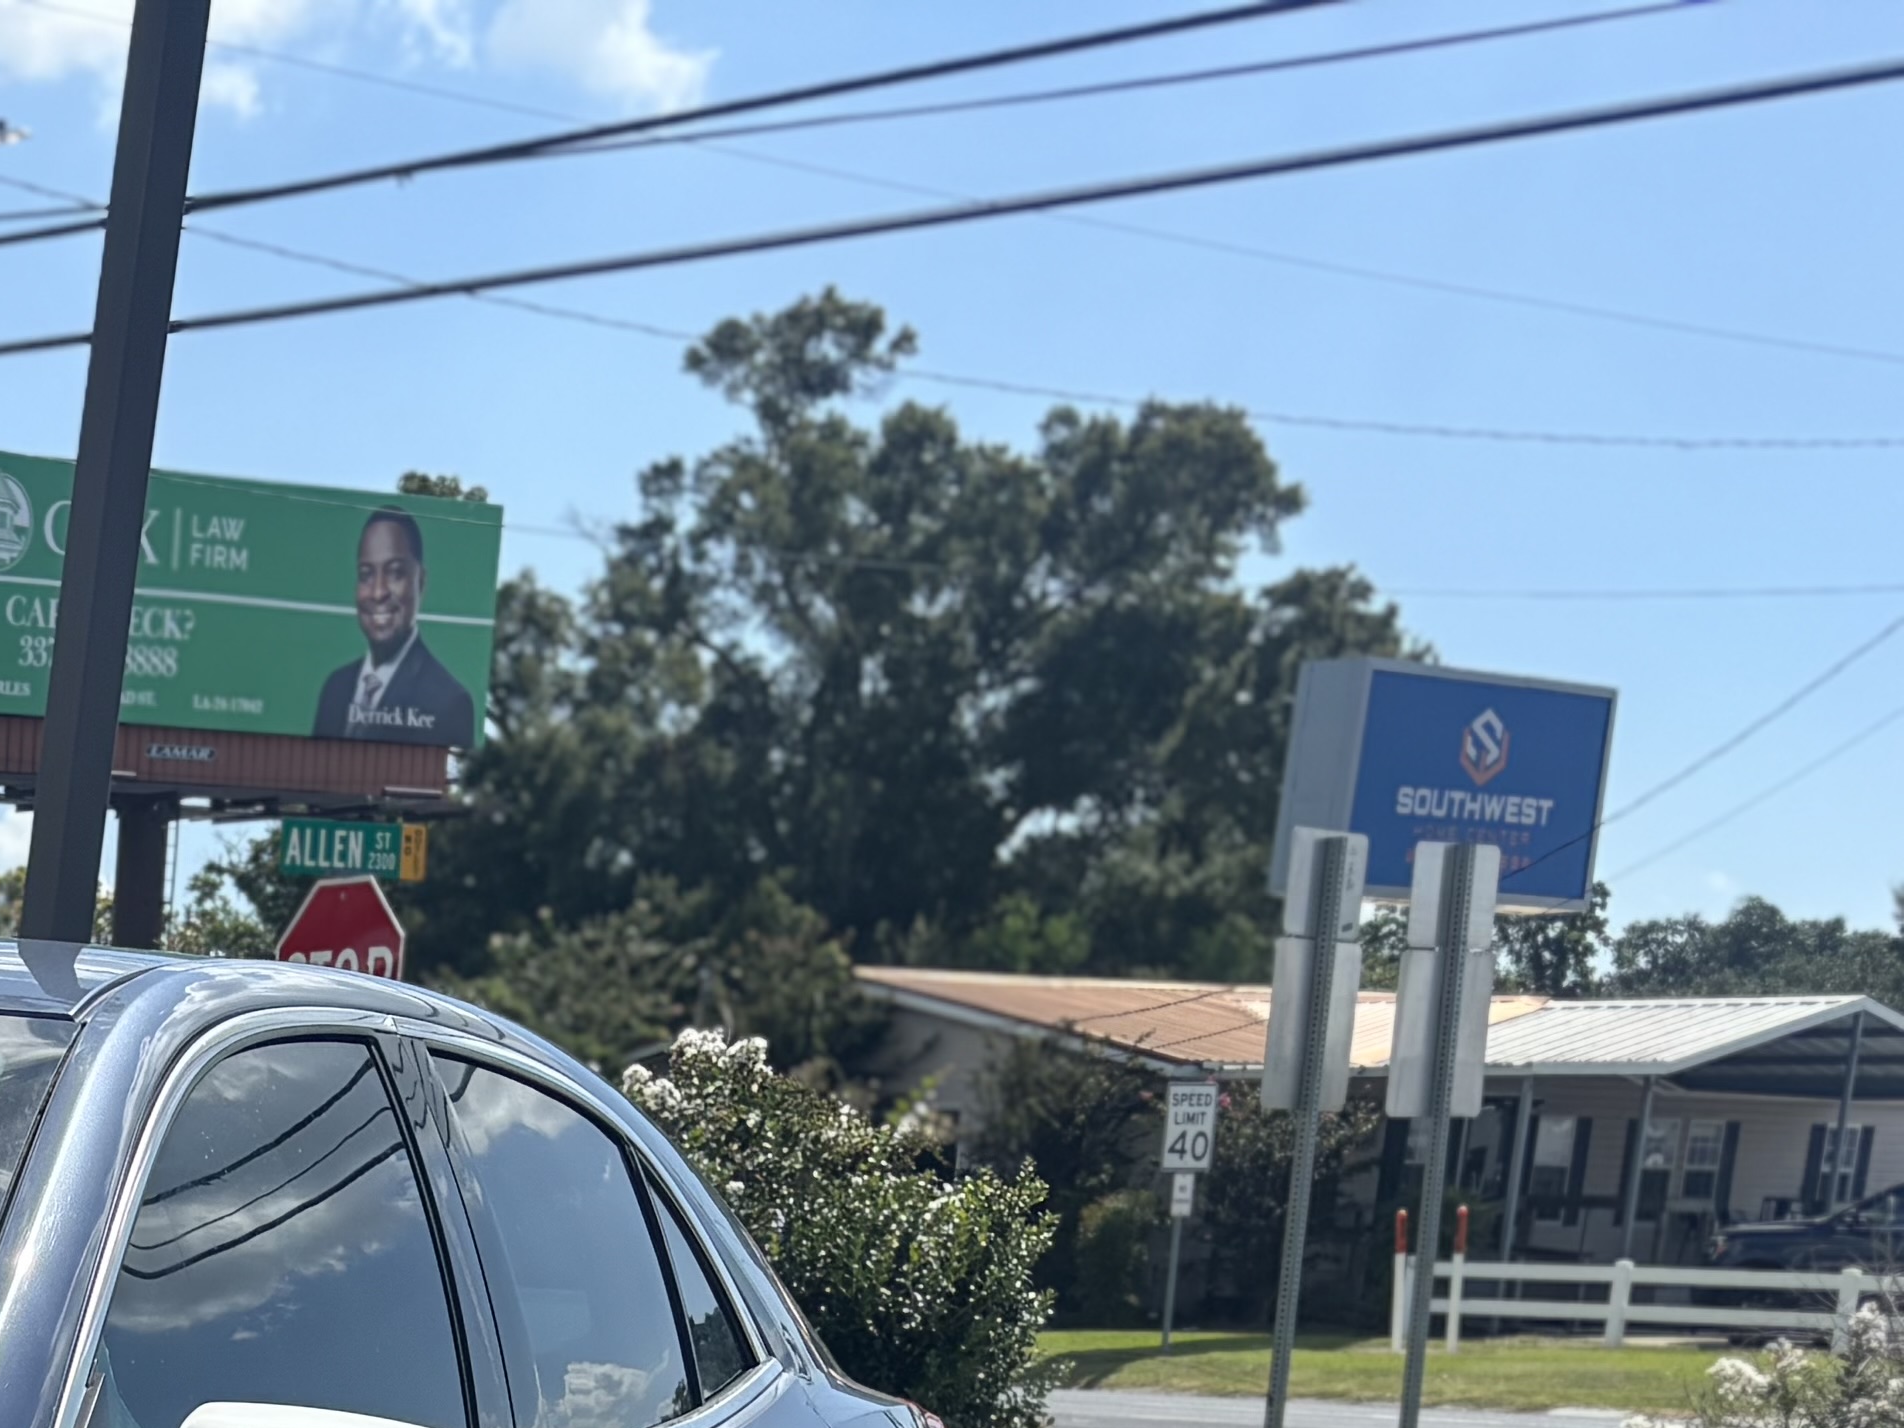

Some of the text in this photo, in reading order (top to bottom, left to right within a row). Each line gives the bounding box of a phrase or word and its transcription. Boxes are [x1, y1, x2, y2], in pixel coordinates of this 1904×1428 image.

[192, 514, 245, 541] LAW
[191, 543, 249, 571] FIRM
[129, 606, 196, 640] ECK?
[348, 703, 435, 728] Derrick Kee
[149, 744, 211, 761] LAMAR
[1396, 786, 1554, 826] SOUTHWEST
[284, 826, 364, 869] ALLEN
[375, 831, 392, 849] ST
[1172, 1093, 1213, 1107] SPEED
[1174, 1112, 1207, 1125] LIMIT
[1167, 1130, 1209, 1161] 40
